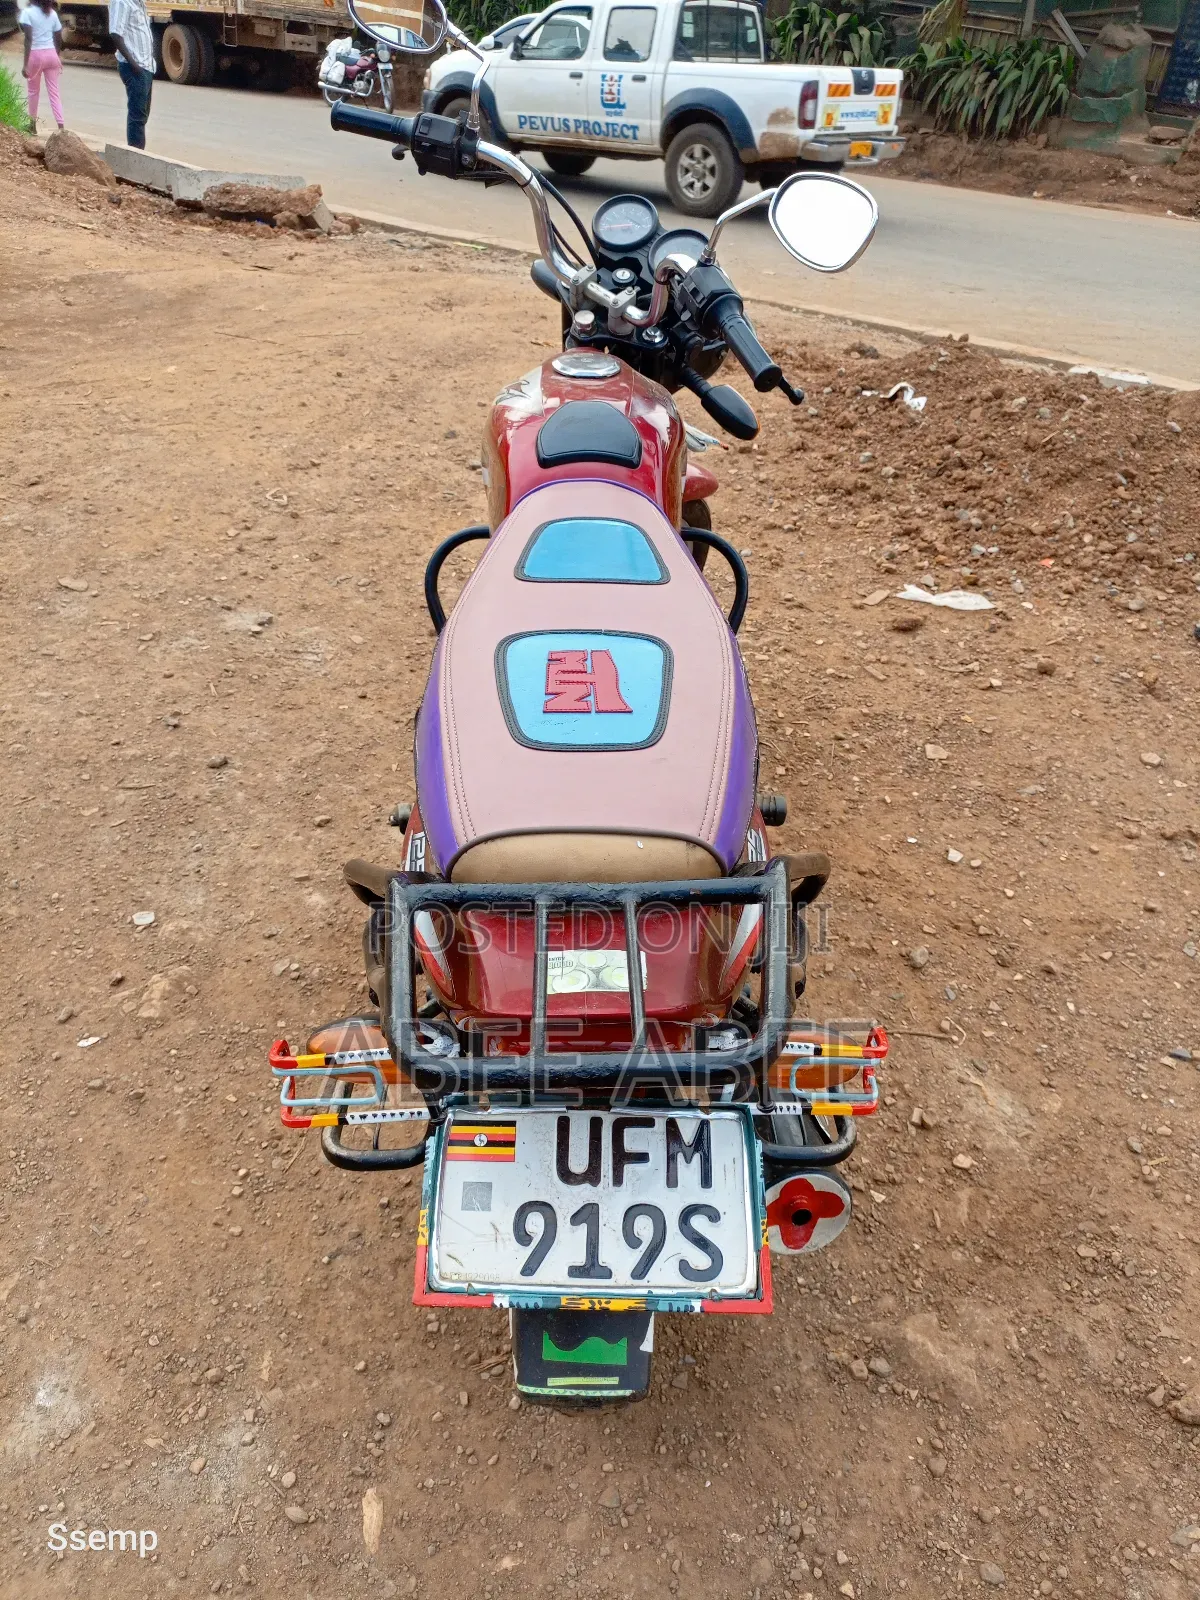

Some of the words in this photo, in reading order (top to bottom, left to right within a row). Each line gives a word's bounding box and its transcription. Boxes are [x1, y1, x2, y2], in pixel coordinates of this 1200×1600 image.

[517, 114, 571, 133] PEVUS
[573, 118, 640, 141] PROJECT
[555, 1115, 713, 1189] UFM
[512, 1200, 724, 1282] 919S
